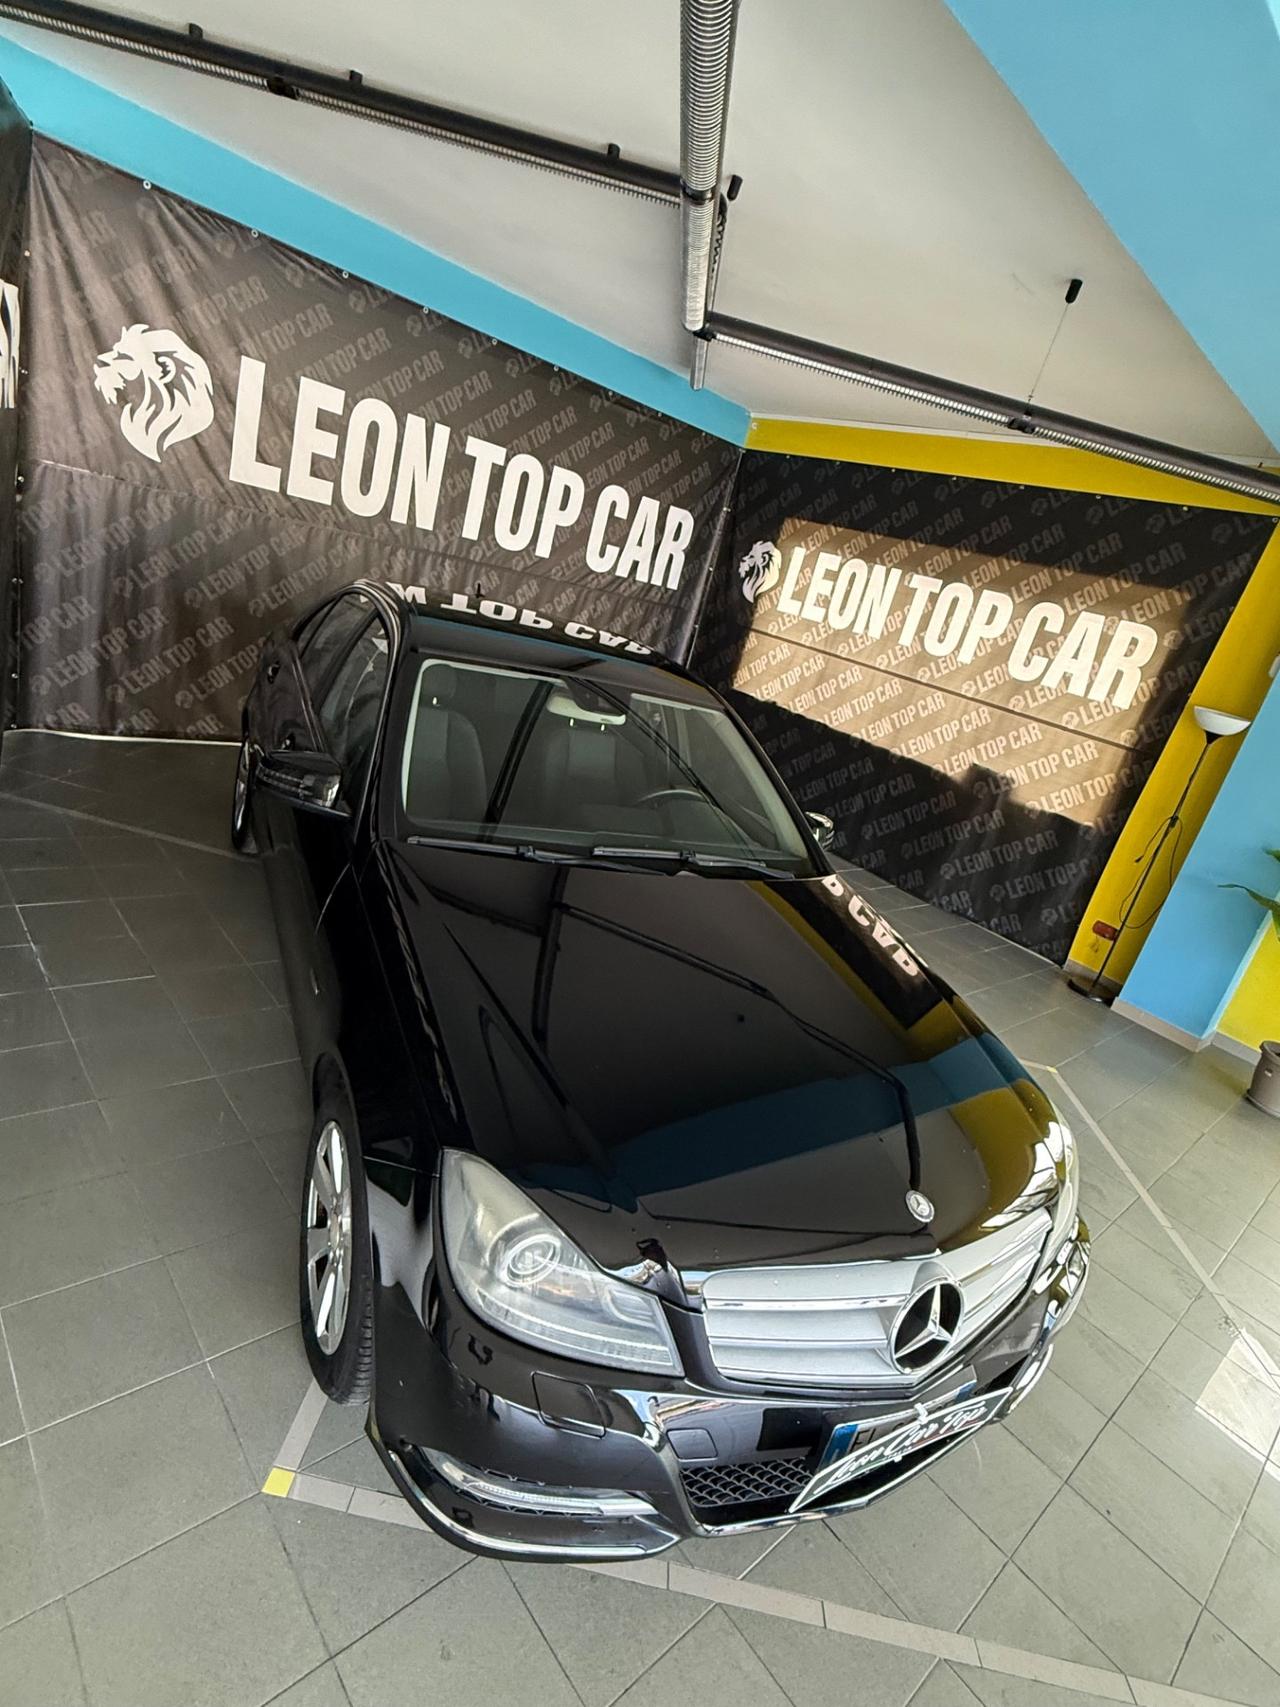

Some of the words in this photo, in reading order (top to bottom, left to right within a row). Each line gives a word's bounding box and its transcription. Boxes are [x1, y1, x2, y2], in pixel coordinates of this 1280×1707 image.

[226, 276, 268, 312] CAR
[261, 320, 296, 353] TOP
[295, 304, 333, 337] CAR
[325, 343, 356, 377] TOP
[357, 327, 392, 360] CAR
[383, 365, 412, 397] TOP
[412, 349, 444, 381] CAR
[435, 384, 463, 416] TOP
[463, 370, 493, 400] CAR
[485, 403, 509, 432] TOP
[509, 389, 536, 418] CAR
[529, 419, 552, 449] TOP
[551, 406, 577, 434] CAR
[570, 434, 592, 462] TOP
[591, 422, 615, 448] CAR
[608, 448, 627, 474] TOP
[626, 436, 650, 462] CAR
[229, 355, 450, 531] LEON
[461, 435, 584, 558] TOP
[587, 485, 694, 590] CAR
[643, 461, 663, 486] TOP
[661, 449, 682, 474] CAR
[676, 474, 693, 496] TOP
[692, 462, 712, 484] CAR
[814, 488, 838, 514] CAR
[851, 494, 878, 520] CAR
[891, 500, 919, 528] CAR
[934, 507, 964, 536] CAR
[130, 548, 180, 590] LEON
[172, 530, 206, 564] TOP
[950, 533, 979, 561] TOP
[980, 515, 1013, 545] CAR
[1000, 542, 1030, 571] TOP
[1030, 523, 1066, 553] CAR
[198, 560, 245, 601] LEON
[238, 543, 271, 575] TOP
[262, 572, 304, 610] LEON
[301, 555, 328, 586] TOP
[1011, 567, 1053, 604] LEON
[1051, 550, 1084, 581] TOP
[1085, 532, 1123, 564] CAR
[1063, 579, 1110, 616] LEON
[1106, 562, 1143, 593] TOP
[1145, 542, 1186, 575] CAR
[1167, 572, 1209, 606] TOP
[51, 596, 97, 630] CAR
[776, 546, 902, 640] LEON
[898, 574, 1014, 665] TOP
[1007, 602, 1158, 710] CAR
[47, 648, 101, 688] LEON
[127, 605, 170, 640] CAR
[119, 655, 172, 694] LEON
[163, 637, 197, 668] TOP
[196, 616, 235, 648] CAR
[749, 657, 768, 680] TOP
[768, 643, 791, 666] CAR
[189, 657, 234, 700] LEON
[230, 643, 261, 675] TOP
[755, 678, 781, 701] LEON
[779, 666, 801, 689] TOP
[800, 654, 825, 677] CAR
[788, 687, 818, 713] LEON
[815, 676, 838, 701] TOP
[838, 665, 863, 689] CAR
[823, 703, 854, 728] LEON
[851, 690, 876, 716] TOP
[876, 678, 903, 704] CAR
[860, 716, 894, 742] LEON
[891, 704, 916, 729] TOP
[917, 692, 946, 718] CAR
[900, 731, 936, 758] LEON
[933, 719, 960, 744] TOP
[960, 707, 992, 733] CAR
[943, 744, 978, 776] LEON
[977, 735, 1006, 762] TOP
[1008, 722, 1043, 749] CAR
[826, 767, 849, 789] TOP
[851, 756, 874, 780] CAR
[1027, 753, 1060, 780] TOP
[1061, 740, 1099, 768] CAR
[835, 793, 865, 818] LEON
[863, 783, 887, 807] TOP
[888, 773, 916, 797] CAR
[873, 811, 905, 838] LEON
[903, 801, 929, 825] TOP
[931, 790, 957, 815] CAR
[1039, 784, 1085, 814] LEON
[1082, 773, 1117, 800] TOP
[913, 829, 945, 856] LEON
[943, 819, 972, 844] TOP
[972, 808, 1006, 834] CAR
[955, 846, 995, 877] LEON
[993, 840, 1023, 865] TOP
[1024, 829, 1059, 855] CAR
[1004, 871, 1047, 899] LEON
[883, 1421, 940, 1459] Car
[939, 1401, 988, 1435] Top
